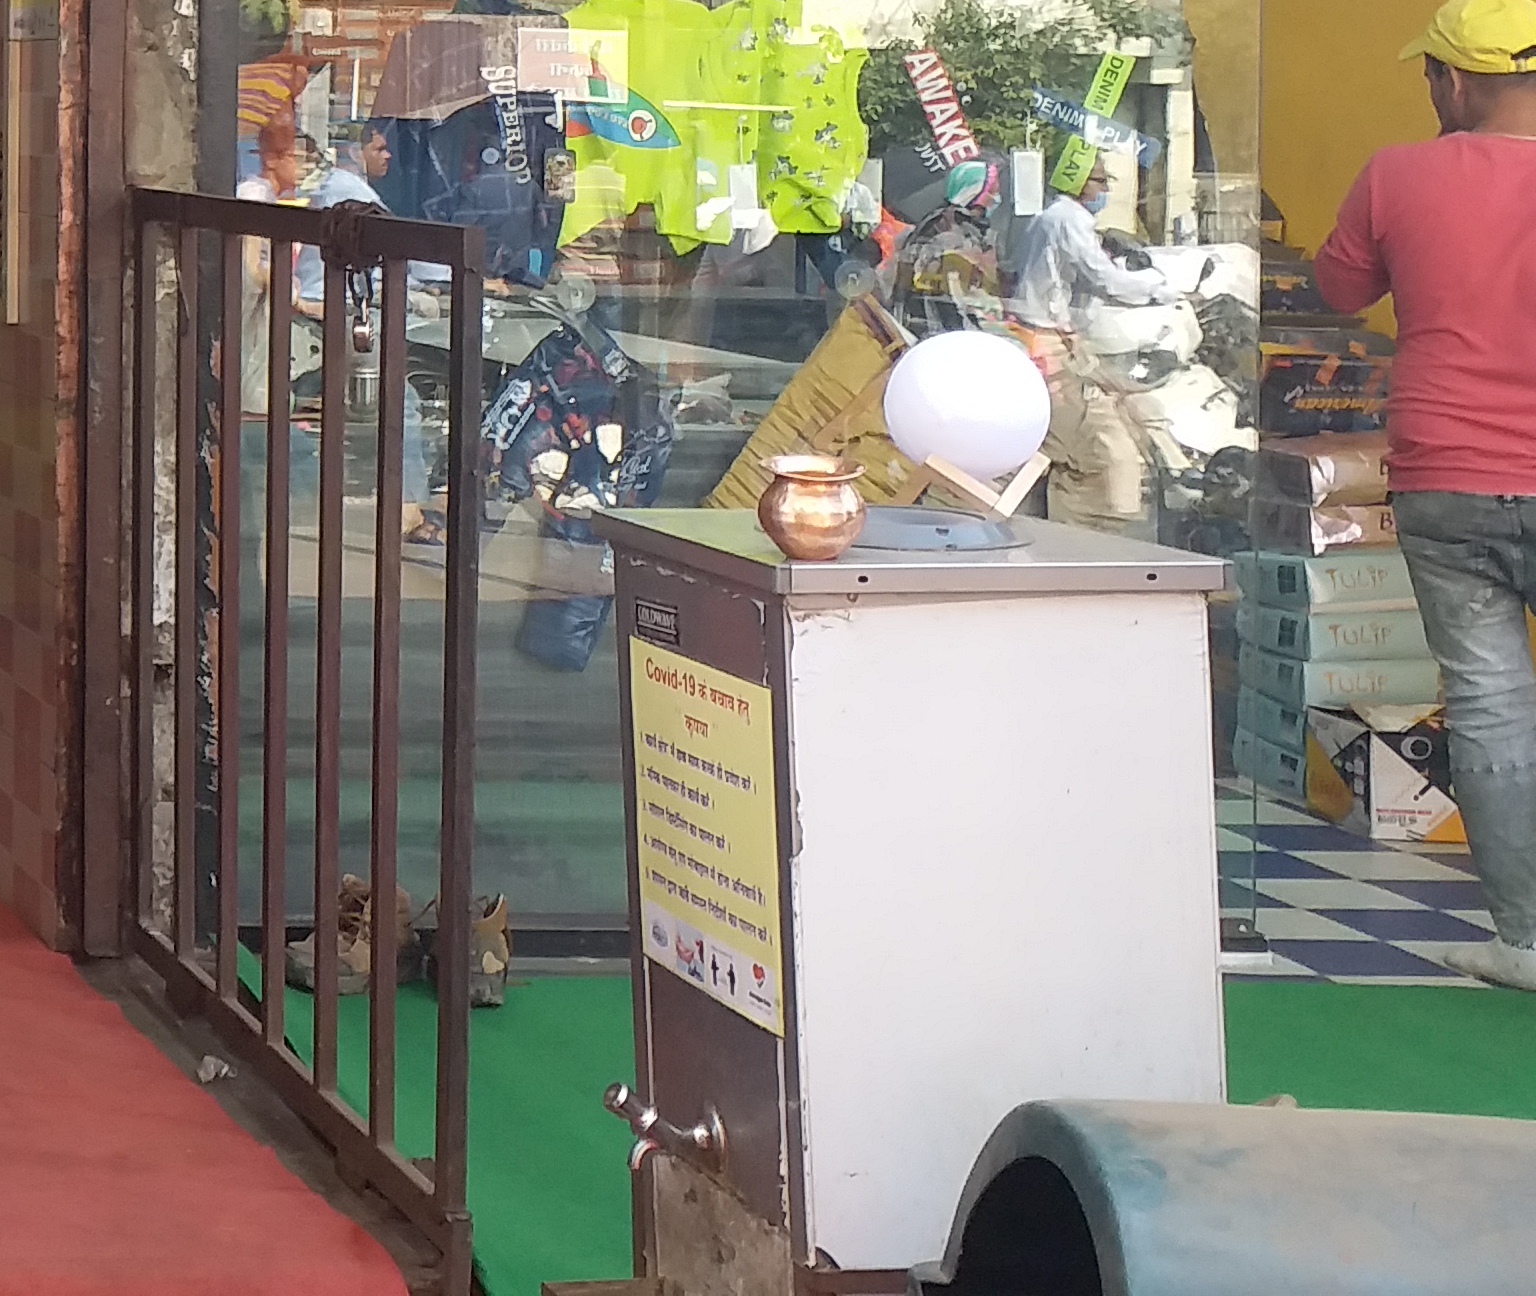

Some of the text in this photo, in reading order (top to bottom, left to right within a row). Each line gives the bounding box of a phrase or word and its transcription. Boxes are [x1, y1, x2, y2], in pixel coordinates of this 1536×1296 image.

[902, 50, 981, 168] AWAKE
[1032, 91, 1086, 128] DENIM
[1060, 55, 1125, 184] DENIM PLAY
[913, 141, 947, 174] JUST
[644, 655, 697, 698] Covid-19
[709, 685, 736, 714] बचाव
